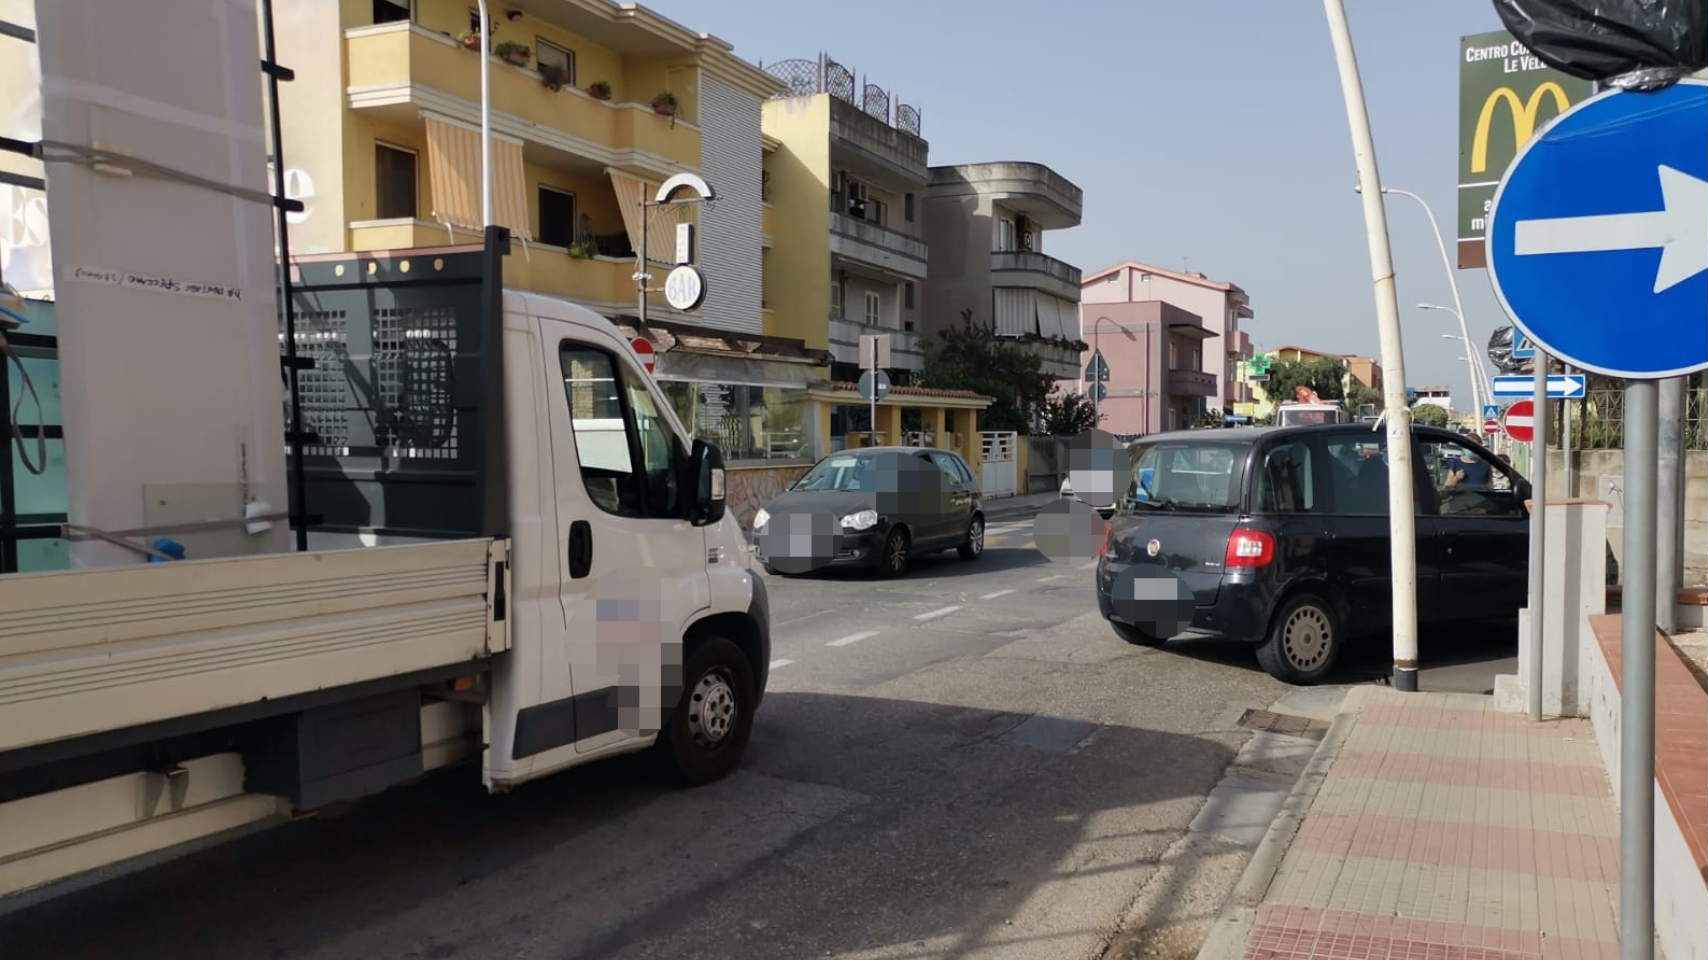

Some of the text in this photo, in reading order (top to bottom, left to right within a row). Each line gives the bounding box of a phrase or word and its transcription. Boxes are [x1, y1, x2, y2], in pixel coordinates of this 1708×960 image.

[1465, 41, 1530, 63] CENTRO CO
[667, 272, 698, 303] BAR
